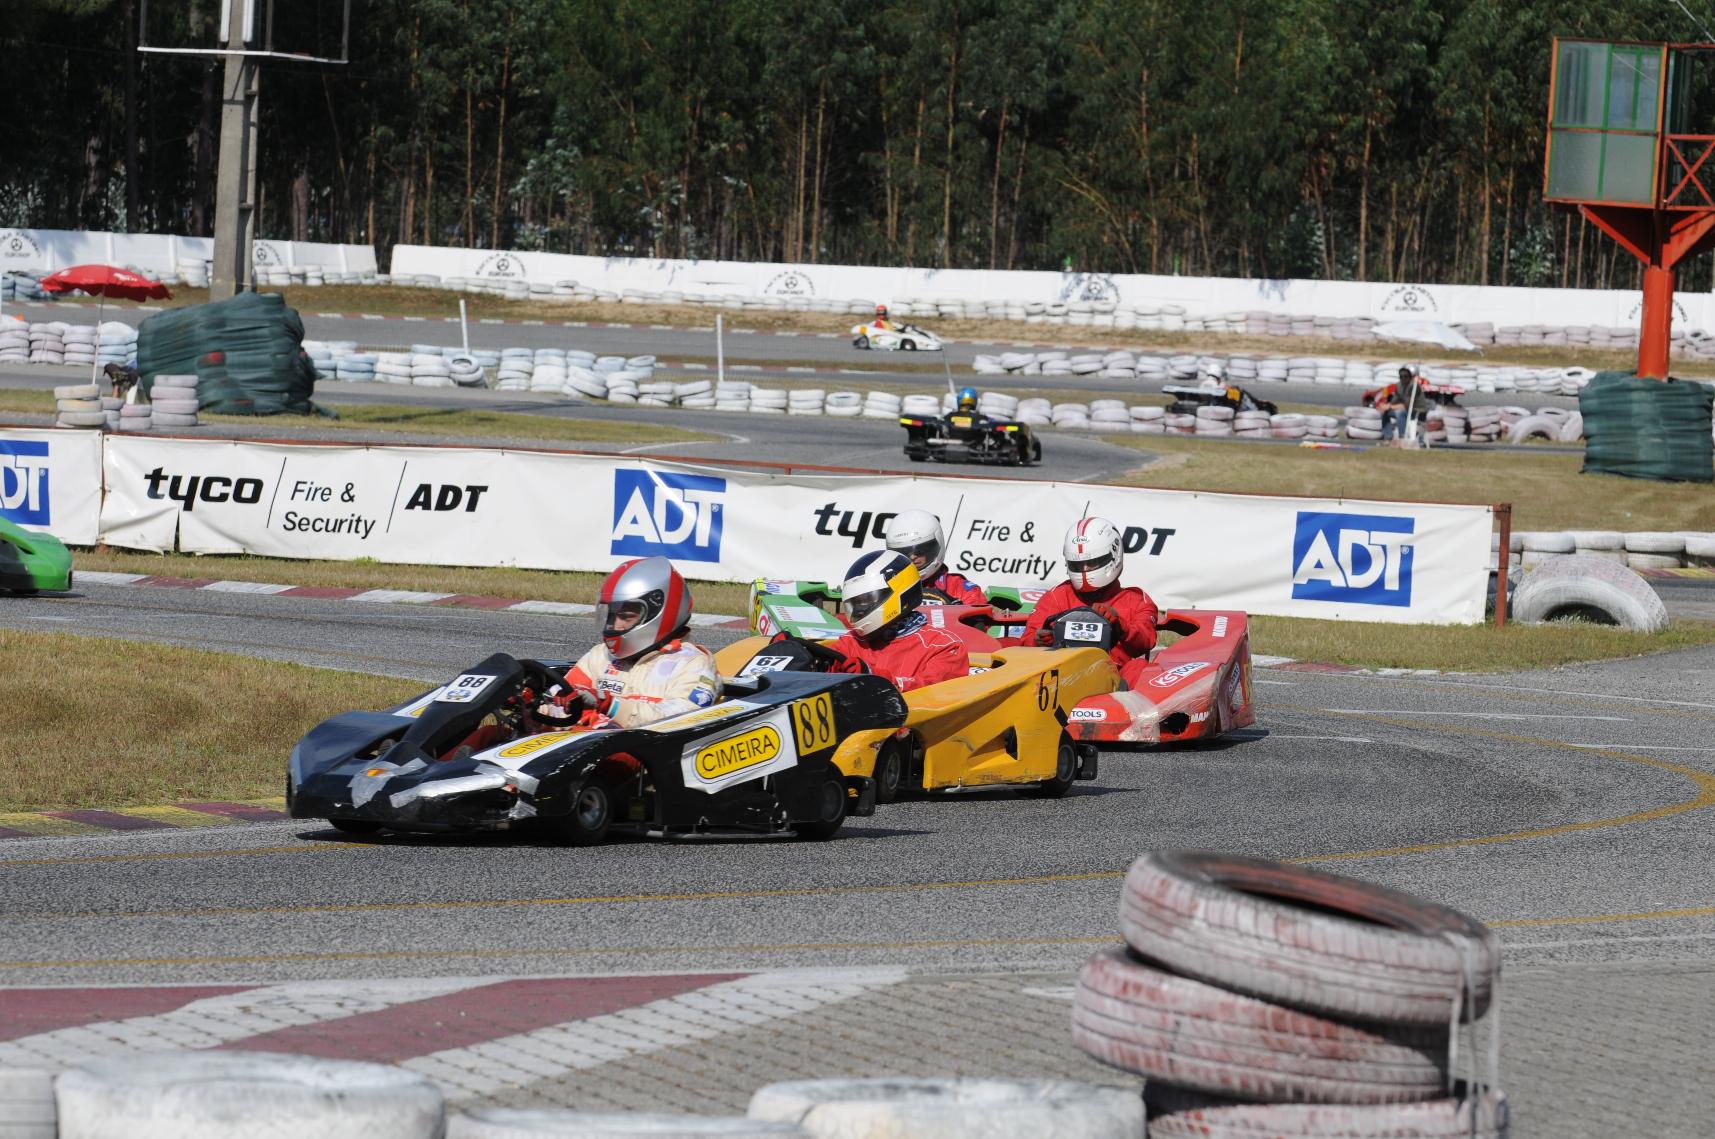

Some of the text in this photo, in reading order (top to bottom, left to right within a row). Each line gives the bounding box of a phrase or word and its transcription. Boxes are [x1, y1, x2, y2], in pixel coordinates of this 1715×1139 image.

[0, 455, 49, 511] DT
[144, 467, 264, 511] tyco
[291, 481, 356, 503] Fire &
[405, 484, 488, 512] ADT
[282, 511, 376, 539] Security
[612, 486, 723, 547] ADT
[814, 501, 902, 548] tyc
[967, 520, 1035, 543] Fire &
[1121, 526, 1176, 556] DT
[957, 551, 1056, 581] Security
[1293, 528, 1414, 591] ADT
[1071, 622, 1098, 632] 39
[756, 656, 788, 667] 67
[458, 676, 488, 688] 88
[602, 681, 622, 692] Beta
[1038, 669, 1059, 711] 67
[800, 697, 829, 748] 88
[1072, 710, 1102, 718] TOOLS
[702, 734, 776, 772] CIMEIRA
